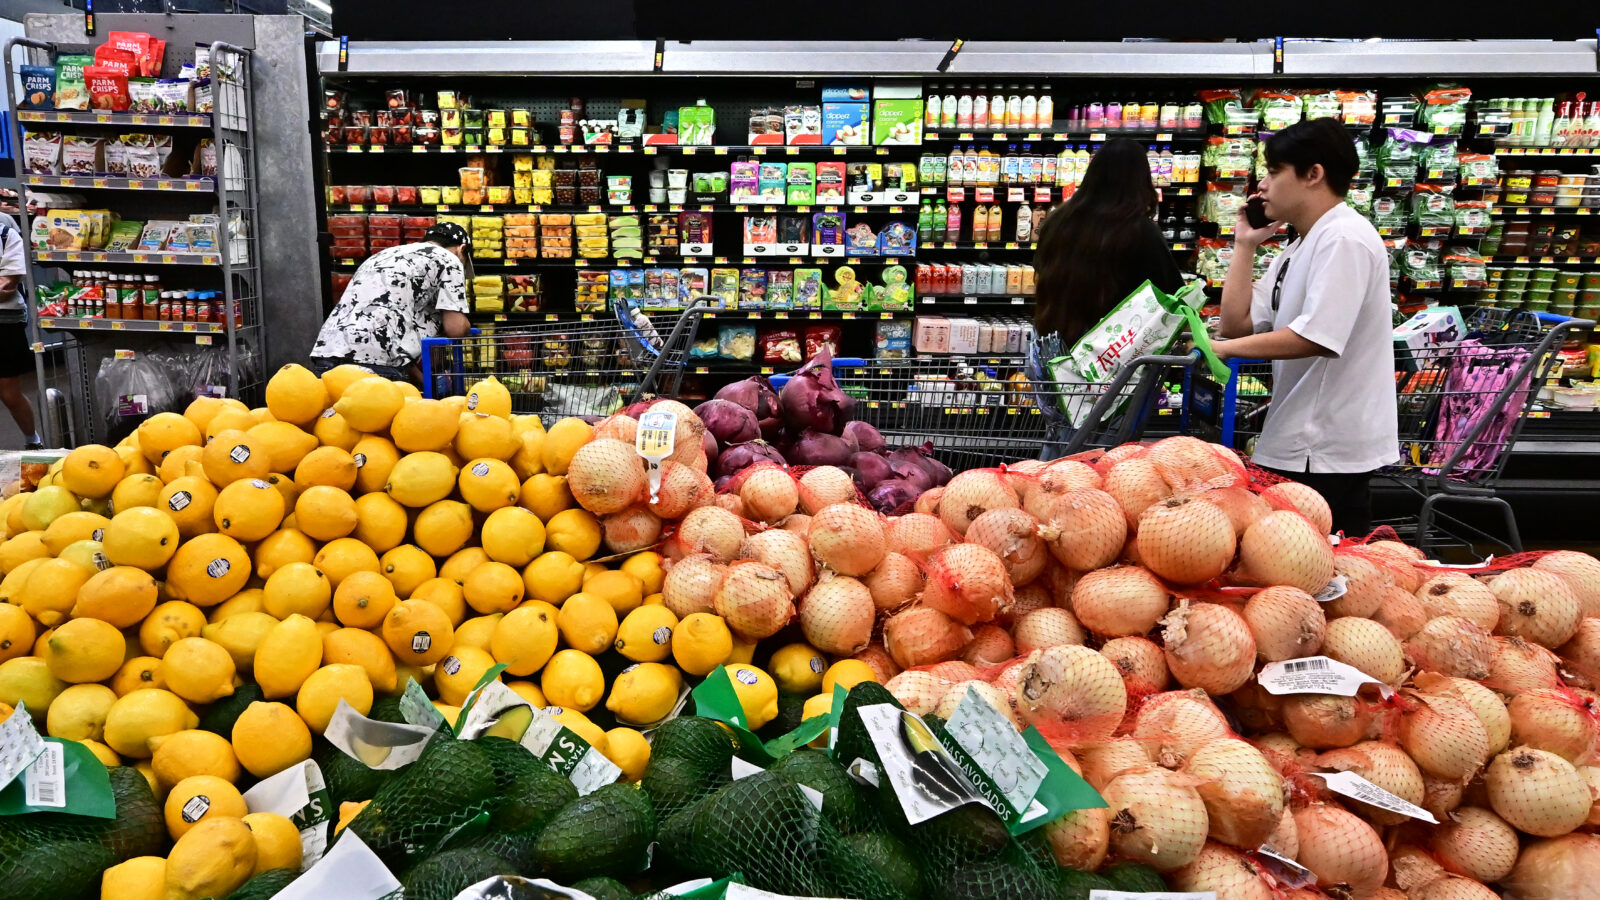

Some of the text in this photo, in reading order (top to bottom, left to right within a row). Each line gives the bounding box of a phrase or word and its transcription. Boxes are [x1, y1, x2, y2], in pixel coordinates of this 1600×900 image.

[103, 61, 128, 69] PARM
[60, 71, 84, 80] CRISP
[25, 82, 52, 91] CRISPS
[90, 85, 119, 94] CRISPS
[564, 745, 585, 773] HASS
[942, 737, 1012, 822] HASS AVOCADOS
